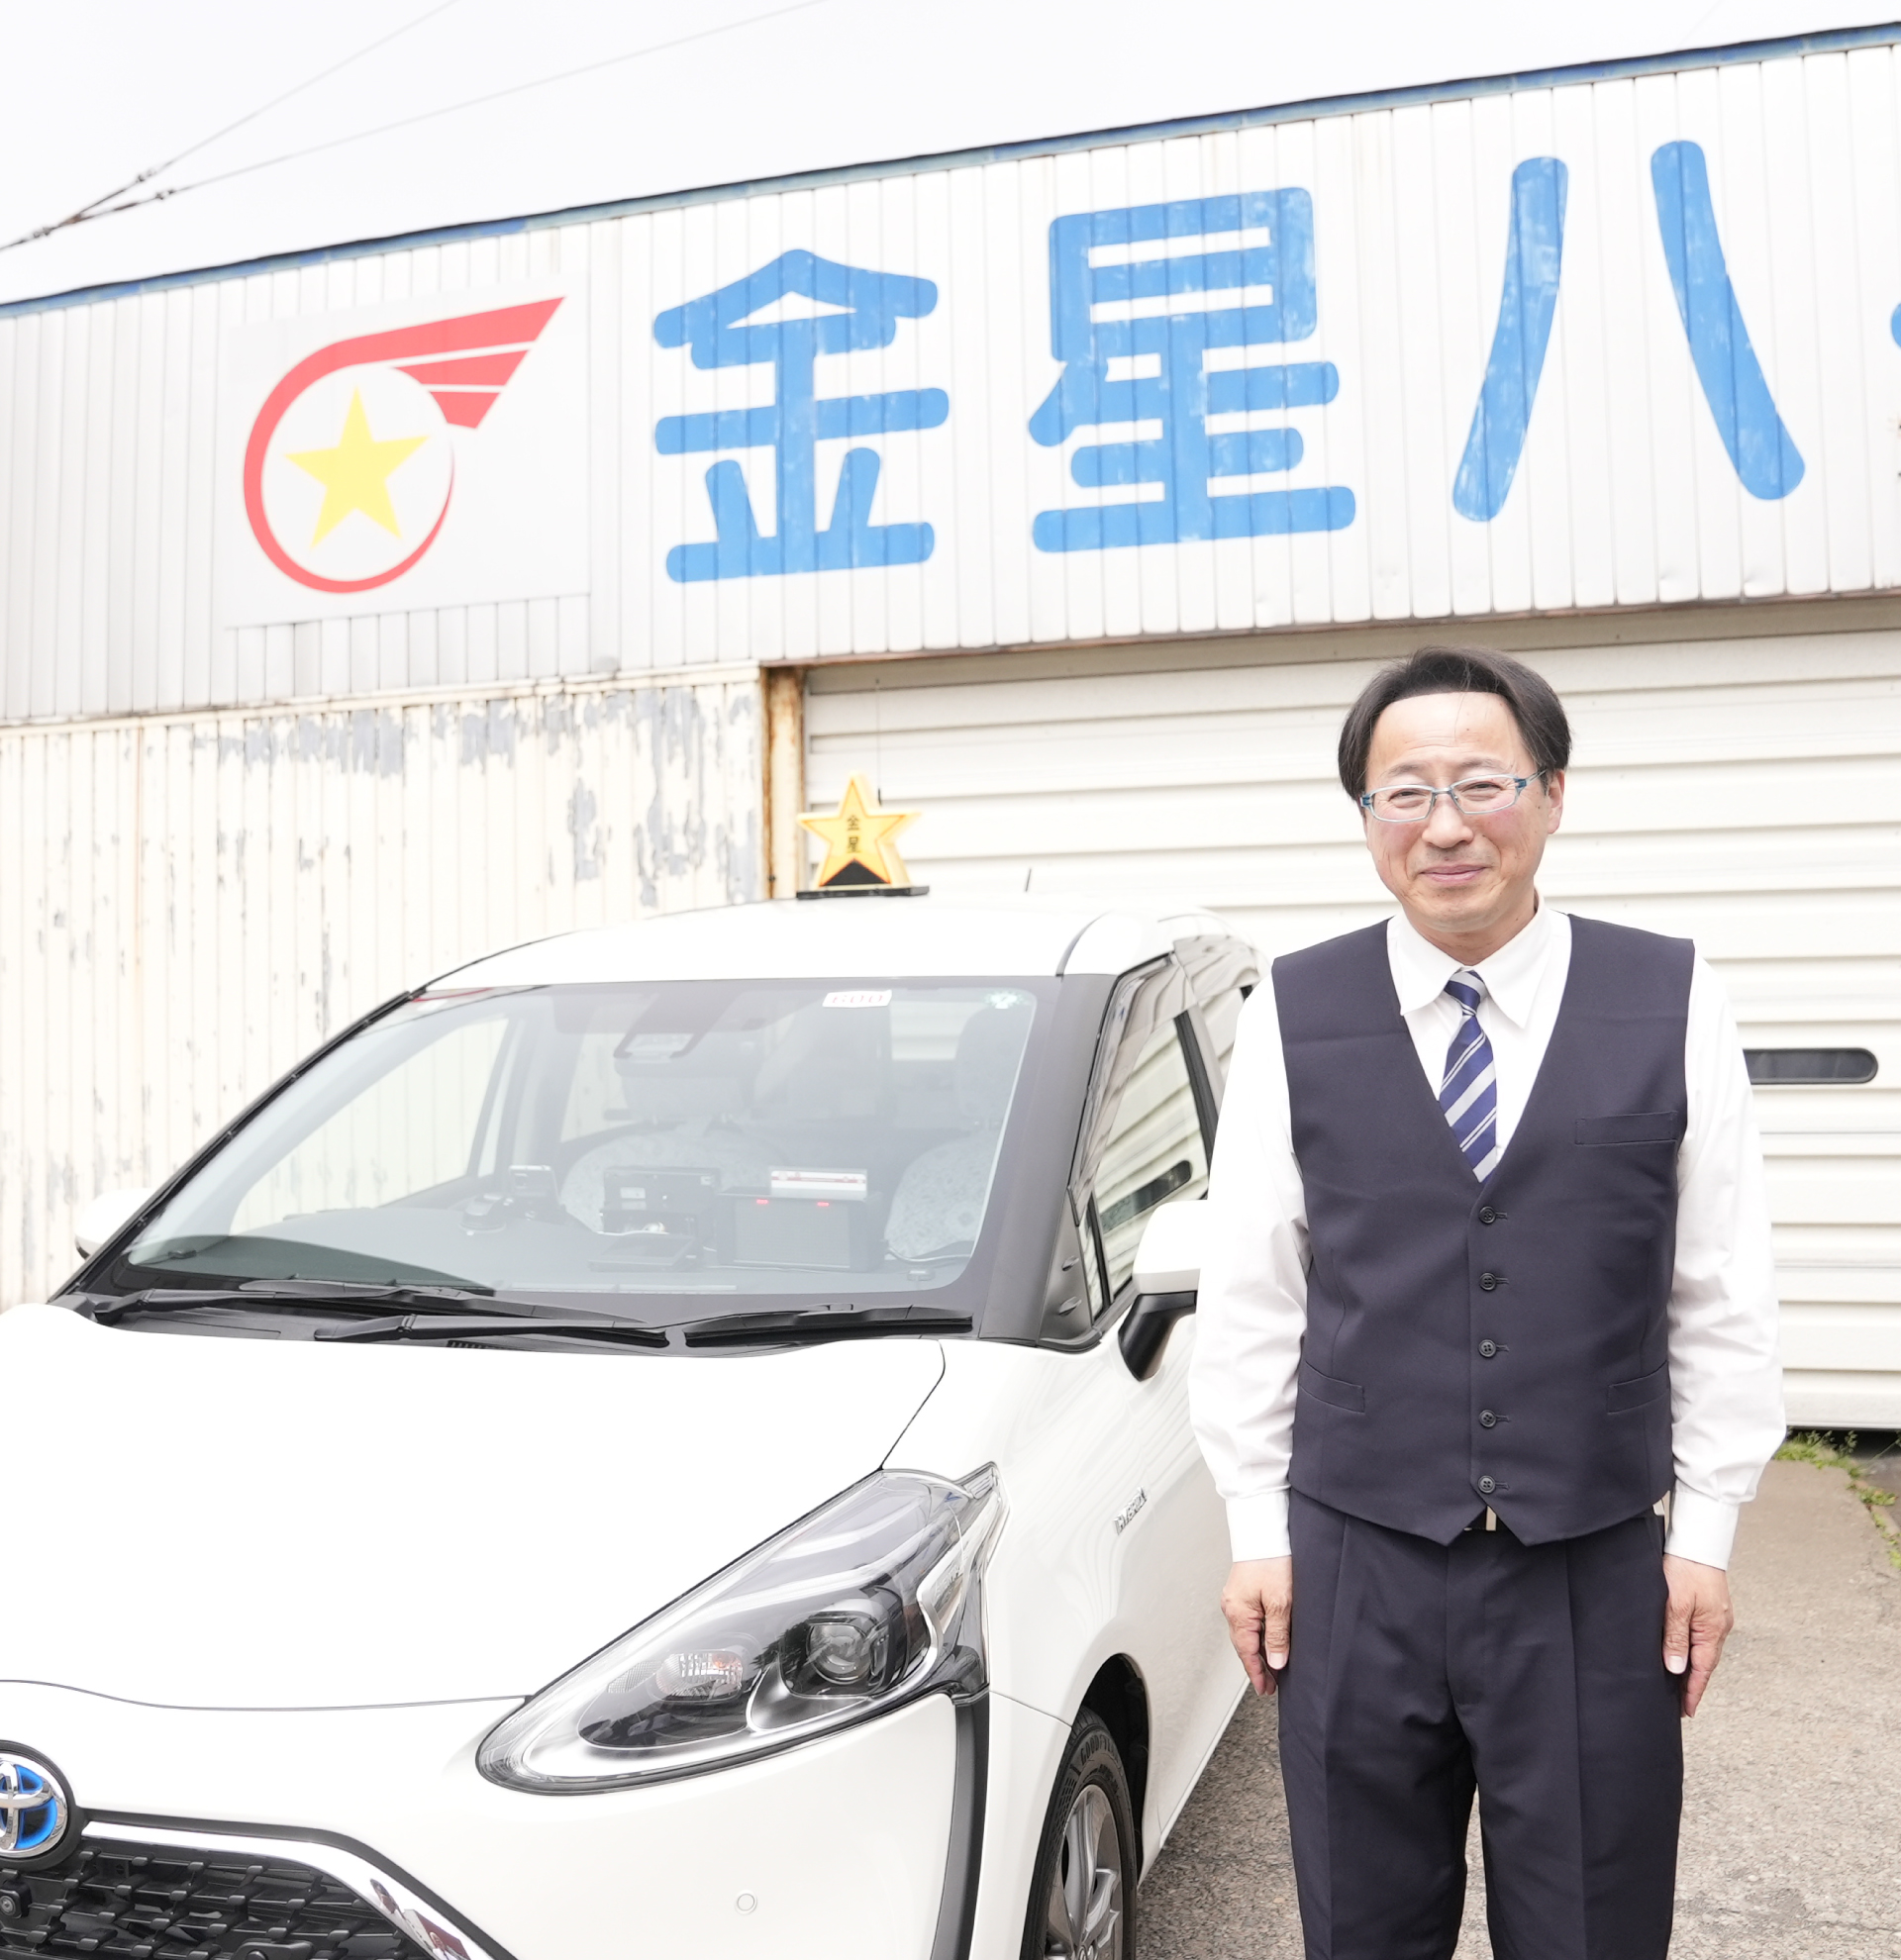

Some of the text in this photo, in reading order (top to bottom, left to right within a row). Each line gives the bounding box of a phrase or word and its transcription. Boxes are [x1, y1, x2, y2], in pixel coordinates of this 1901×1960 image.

[653, 140, 1901, 583] 金星ハ
[847, 814, 861, 854] 金星
